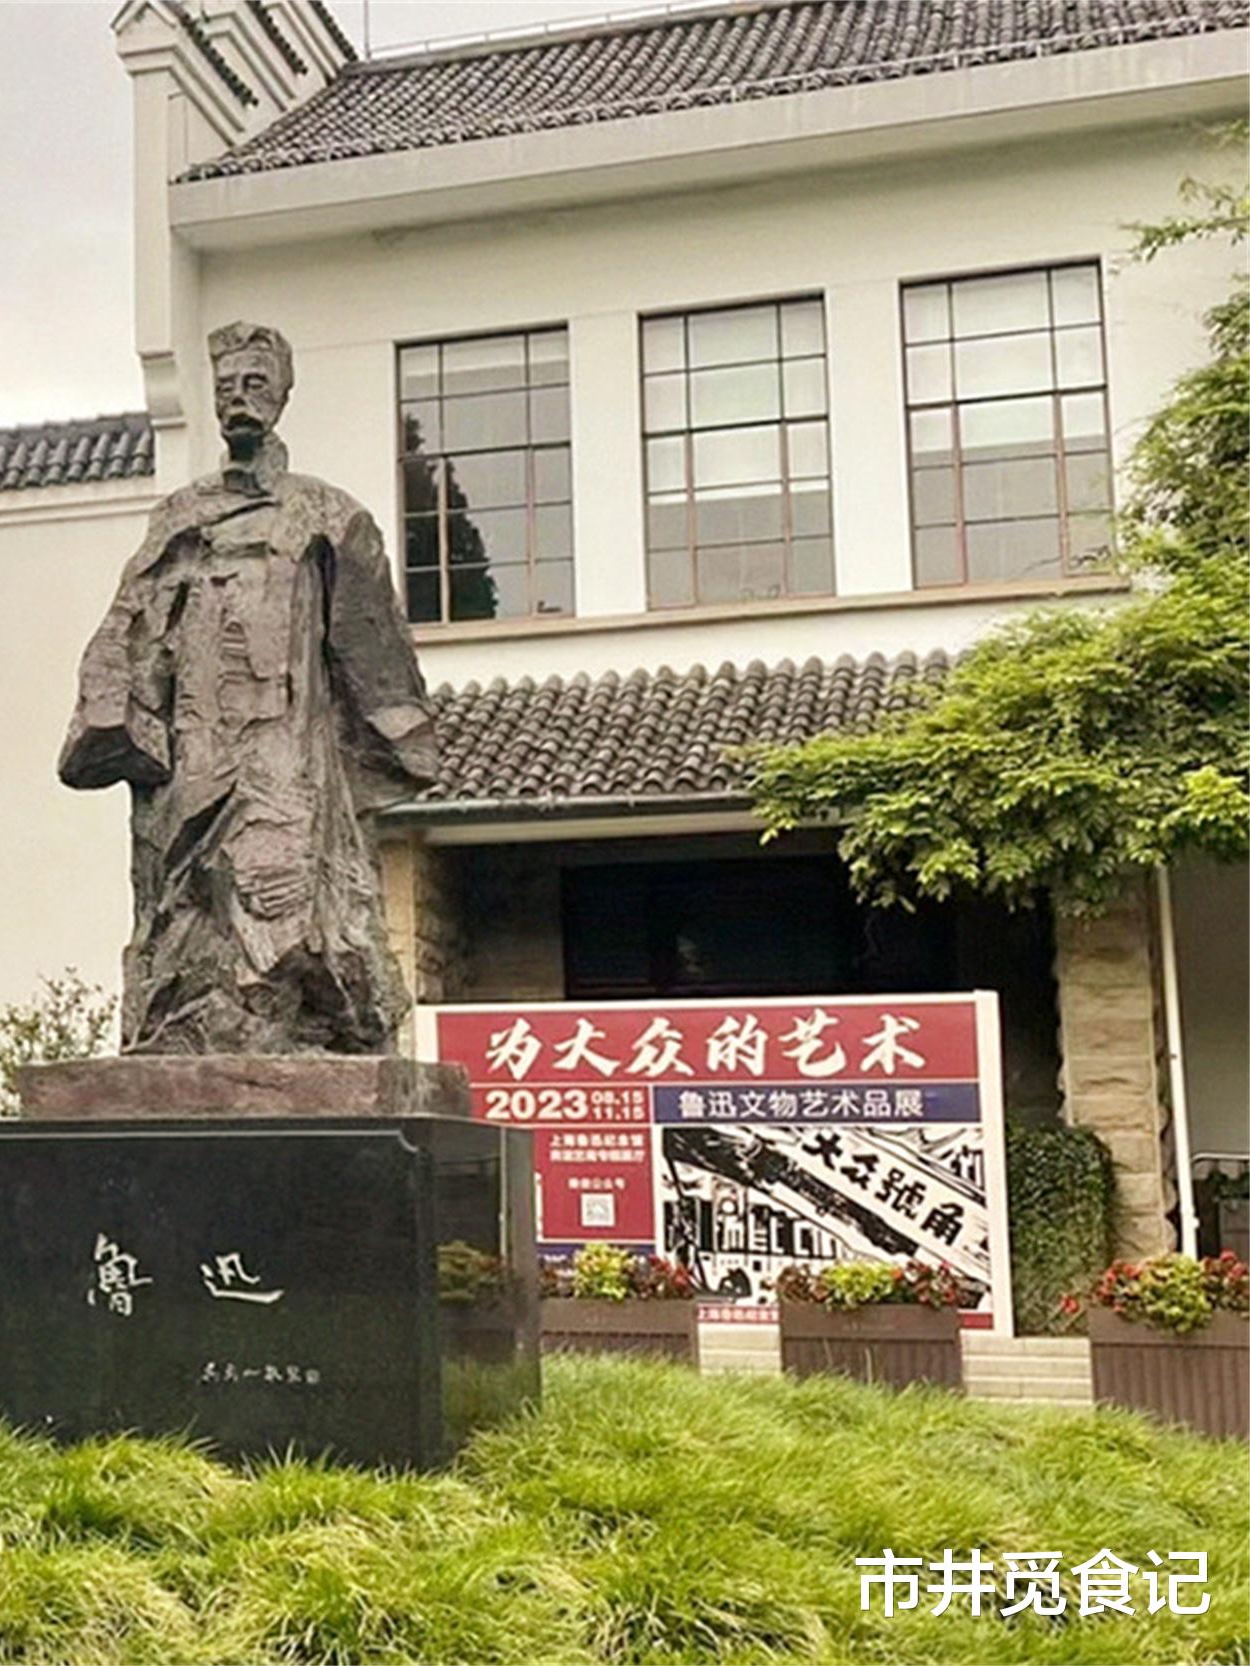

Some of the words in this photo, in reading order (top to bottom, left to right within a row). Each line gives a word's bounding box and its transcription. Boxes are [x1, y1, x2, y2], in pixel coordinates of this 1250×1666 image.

[485, 1010, 927, 1081] 为大众的艺术
[485, 1089, 589, 1120] 2023
[592, 1106, 645, 1120] 11.15
[678, 1087, 924, 1120] 鲁迅文物艺术品展
